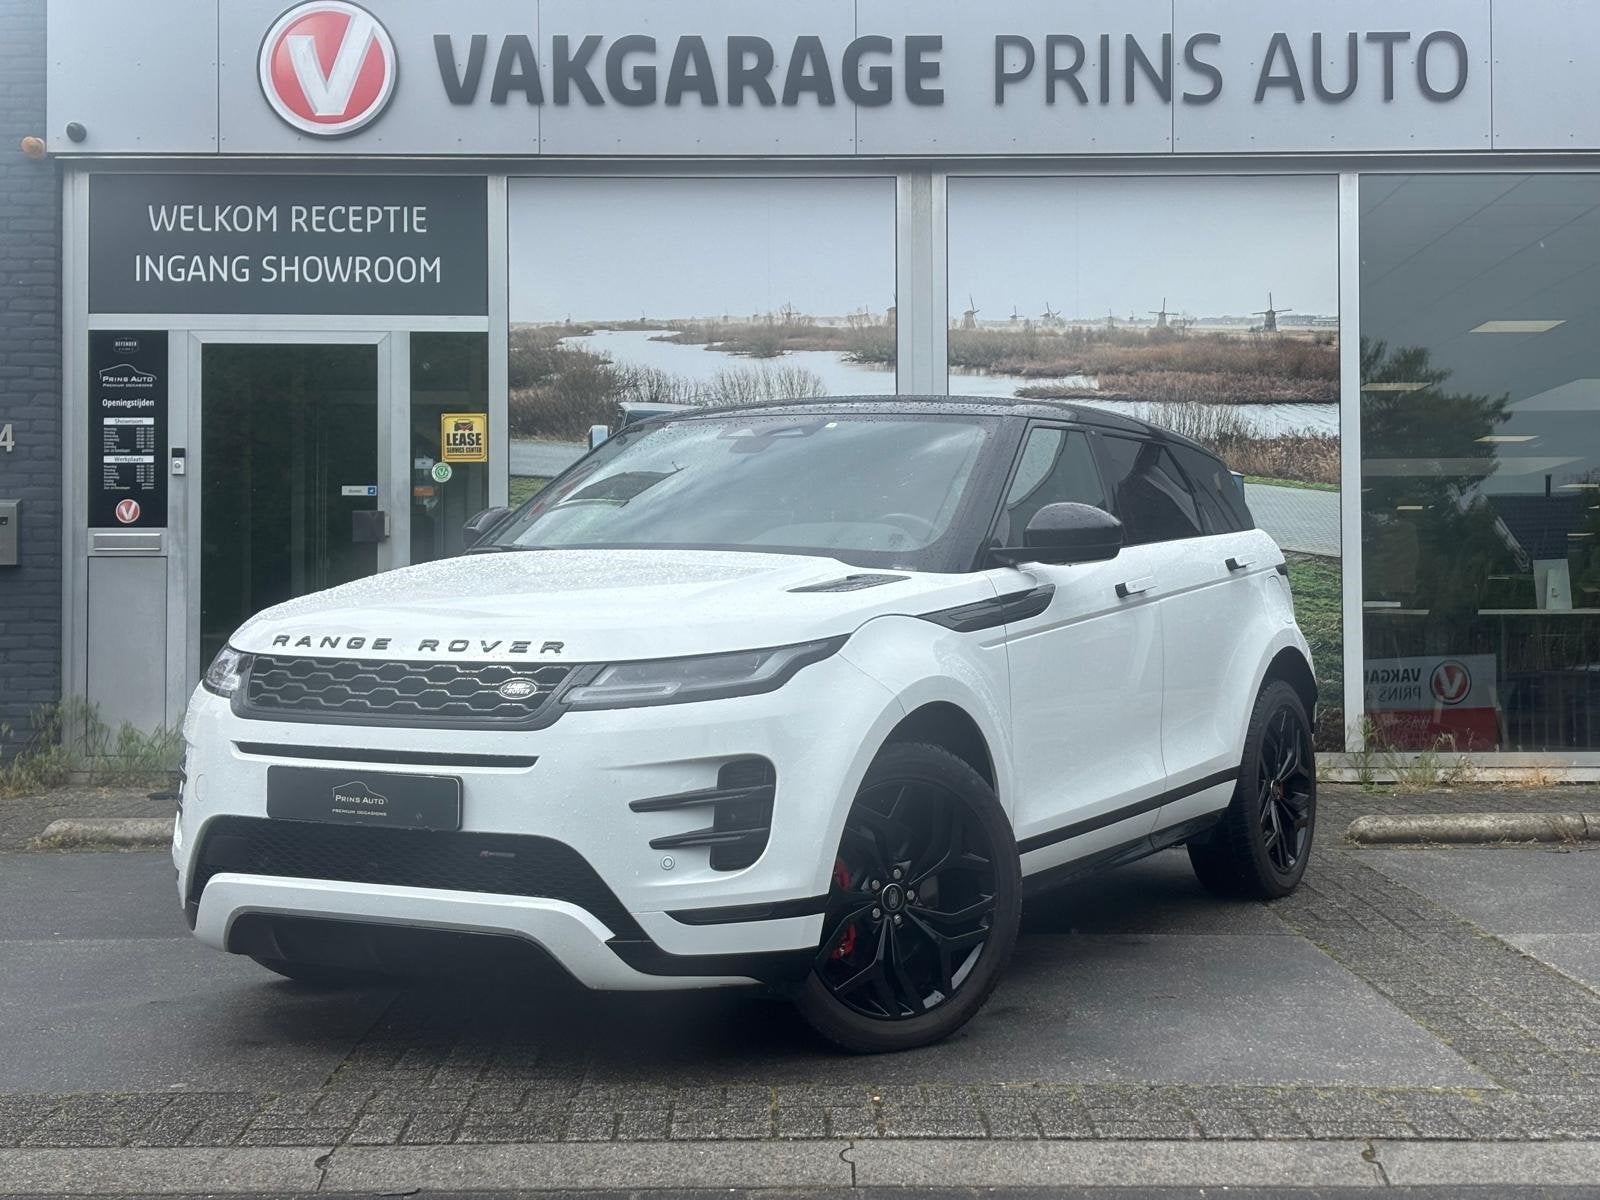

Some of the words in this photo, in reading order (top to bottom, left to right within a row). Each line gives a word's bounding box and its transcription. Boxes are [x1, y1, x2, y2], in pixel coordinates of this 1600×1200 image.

[432, 34, 945, 107] VAKGARAGE
[995, 32, 1224, 105] PRINS
[1253, 30, 1469, 103] AUTO
[148, 204, 278, 232] WELKOM
[291, 205, 427, 233] RECEPTIE
[135, 254, 250, 282] INGANG
[261, 255, 441, 283] SHOWROOM
[102, 398, 155, 409] Openingstijden
[446, 432, 482, 446] LEASE
[446, 446, 465, 454] SERVICE
[465, 446, 482, 454] CENTER
[114, 455, 144, 463] Werkplaats
[272, 634, 392, 651] RANGE
[417, 638, 566, 654] ROVER
[335, 794, 361, 803] PRINS
[361, 796, 385, 805] AUTO
